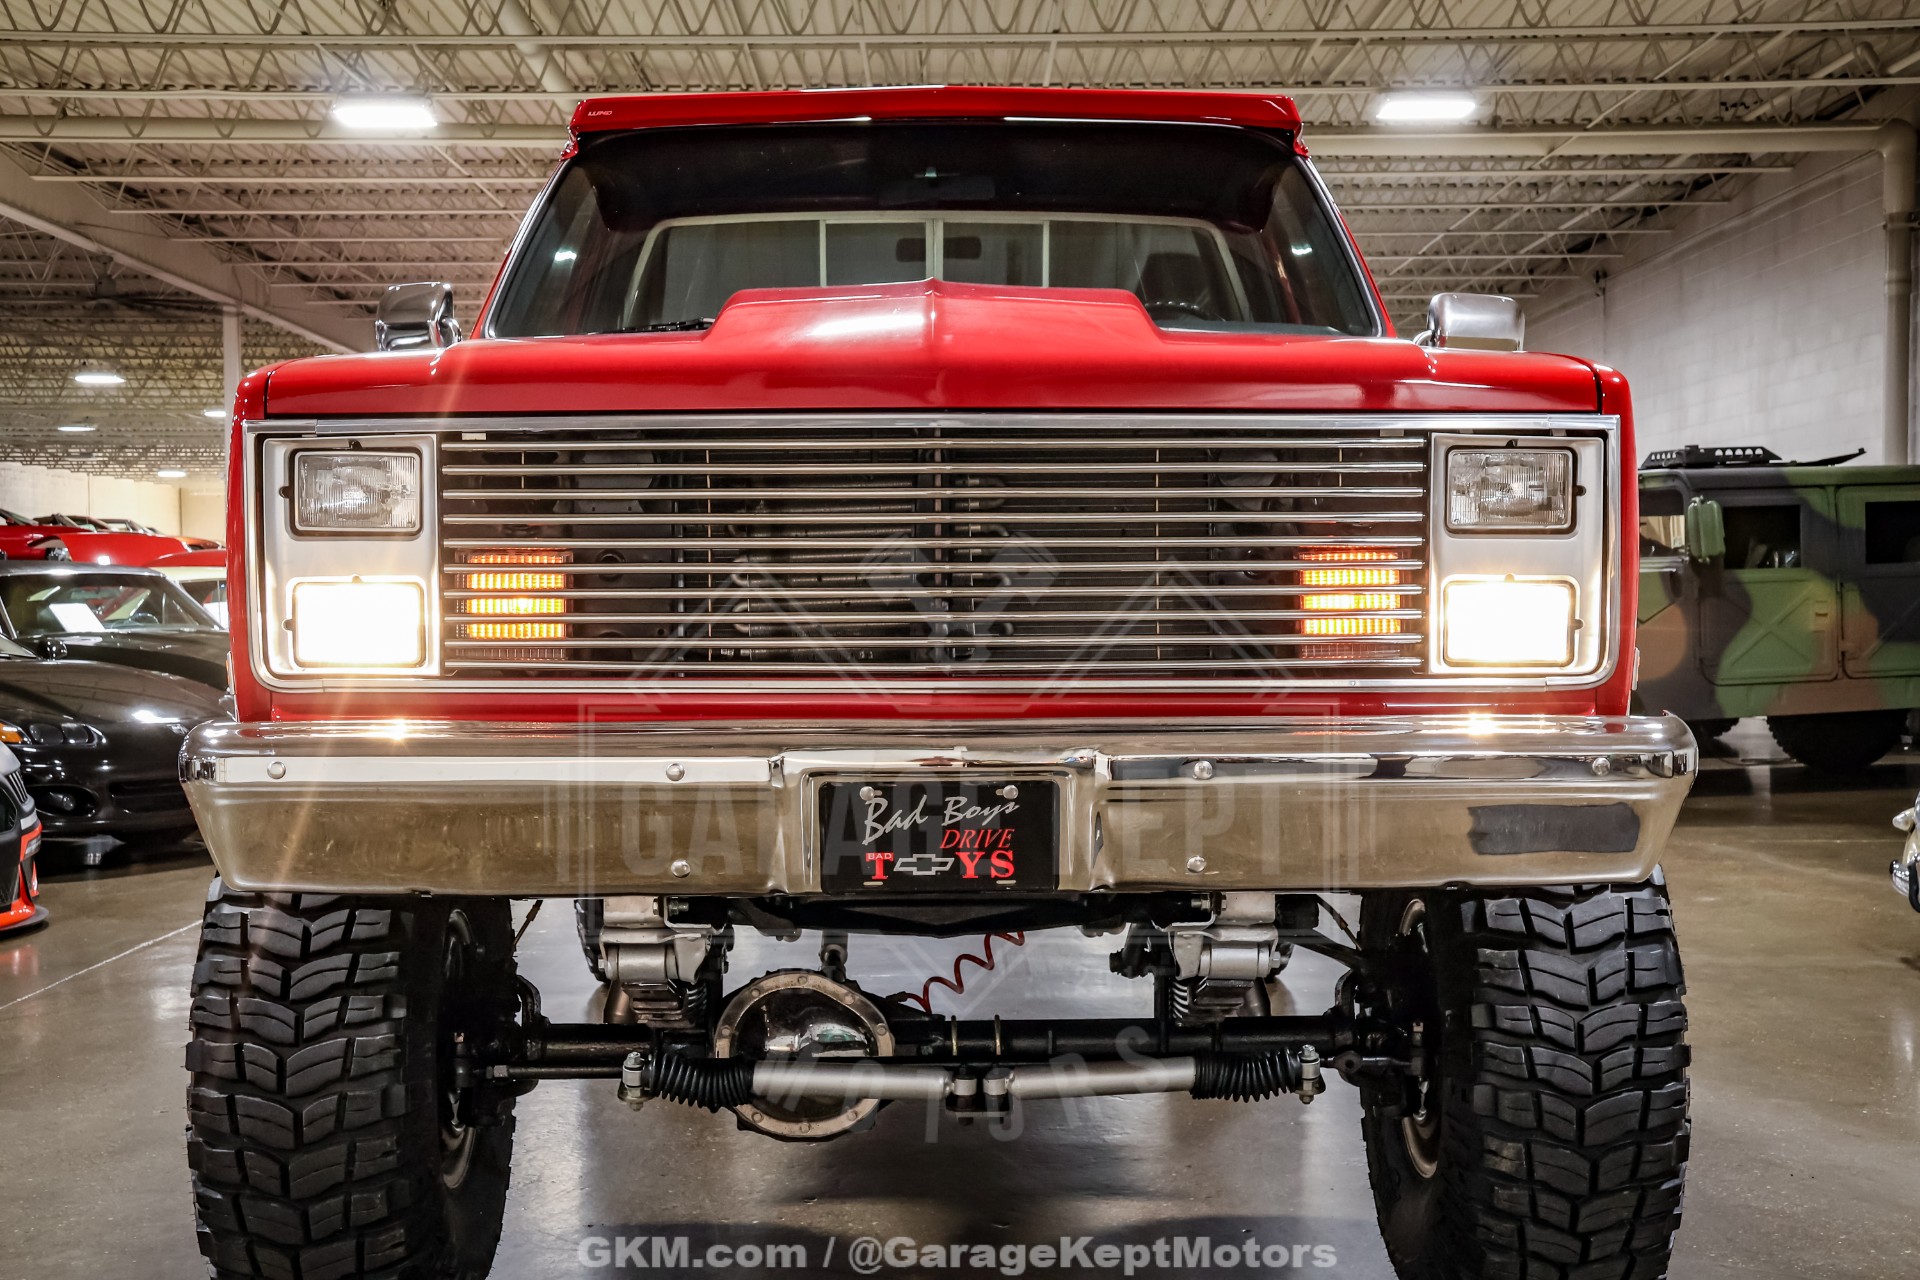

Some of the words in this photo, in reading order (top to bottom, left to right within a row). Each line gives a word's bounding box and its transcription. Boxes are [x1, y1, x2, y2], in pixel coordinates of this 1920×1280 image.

[862, 794, 929, 846] Bad
[941, 796, 1020, 827] Boys
[940, 829, 1015, 849] DRIVE
